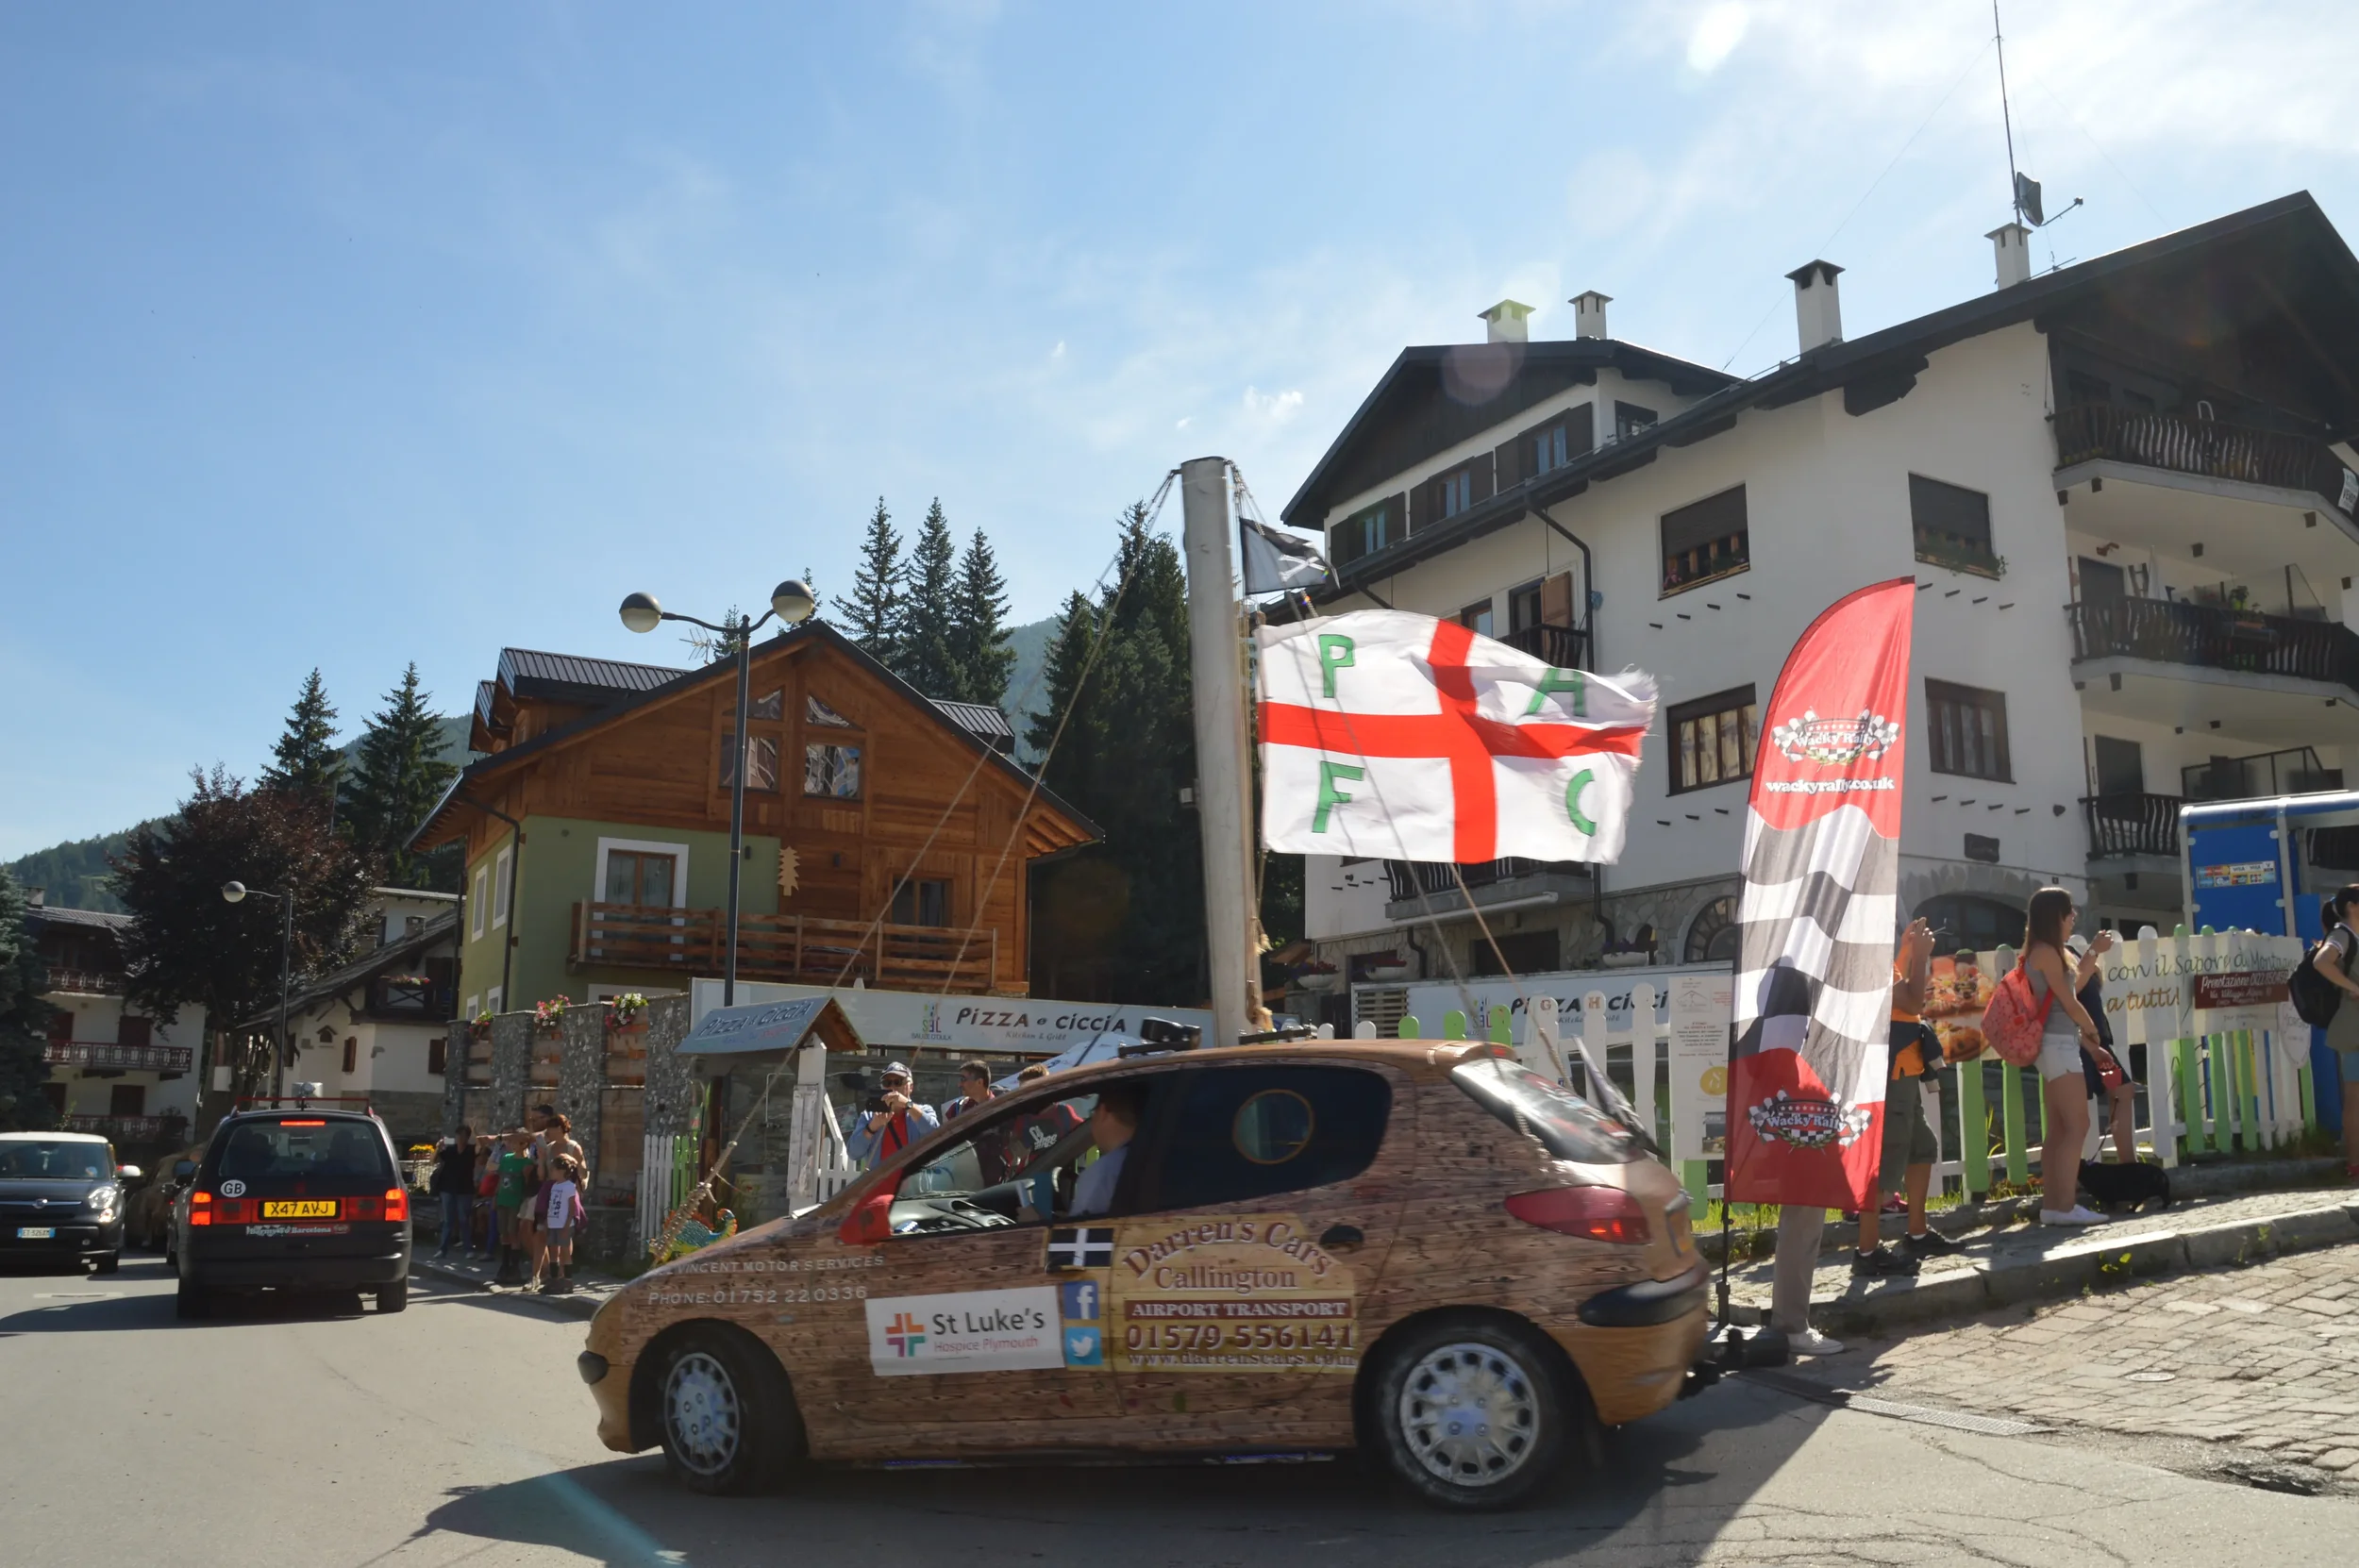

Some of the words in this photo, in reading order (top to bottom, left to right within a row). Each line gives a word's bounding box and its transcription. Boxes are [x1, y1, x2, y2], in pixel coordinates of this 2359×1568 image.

[1318, 634, 1355, 698] P
[1524, 668, 1586, 717] A
[1796, 731, 1839, 747] Wacky
[1843, 732, 1876, 745] Rally
[1765, 776, 1896, 795] wackyrally.co.uk
[1312, 760, 1365, 833] F
[1565, 769, 1597, 837] C
[2108, 964, 2151, 982] con
[2155, 955, 2172, 976] il
[2106, 997, 2125, 1013] a
[2126, 987, 2181, 1011] tutti!
[1005, 1030, 1036, 1040] Kitchen
[1766, 1113, 1812, 1127] Wacky
[1814, 1114, 1846, 1131] Rally
[224, 1182, 243, 1194] GB
[271, 1203, 298, 1215] X47
[302, 1203, 328, 1214] AVJ
[1123, 1216, 1257, 1279] Darren's
[1265, 1222, 1331, 1276] Cars
[678, 1261, 741, 1274] VINCENT
[744, 1260, 799, 1272] MOTOR
[804, 1256, 884, 1271] SERVICES
[1155, 1266, 1299, 1296] Callington
[785, 1286, 868, 1303] 220336
[1132, 1303, 1219, 1317] AIRPORT
[1224, 1302, 1347, 1316] TRANSPORT
[931, 1313, 959, 1336] St
[965, 1308, 1046, 1333] Luke's
[934, 1341, 979, 1354] Hospice
[982, 1336, 1039, 1353] Plymouth
[1128, 1325, 1224, 1350] 01579
[1234, 1323, 1355, 1350] 556141
[1128, 1351, 1357, 1367] www.darrenscars.com
